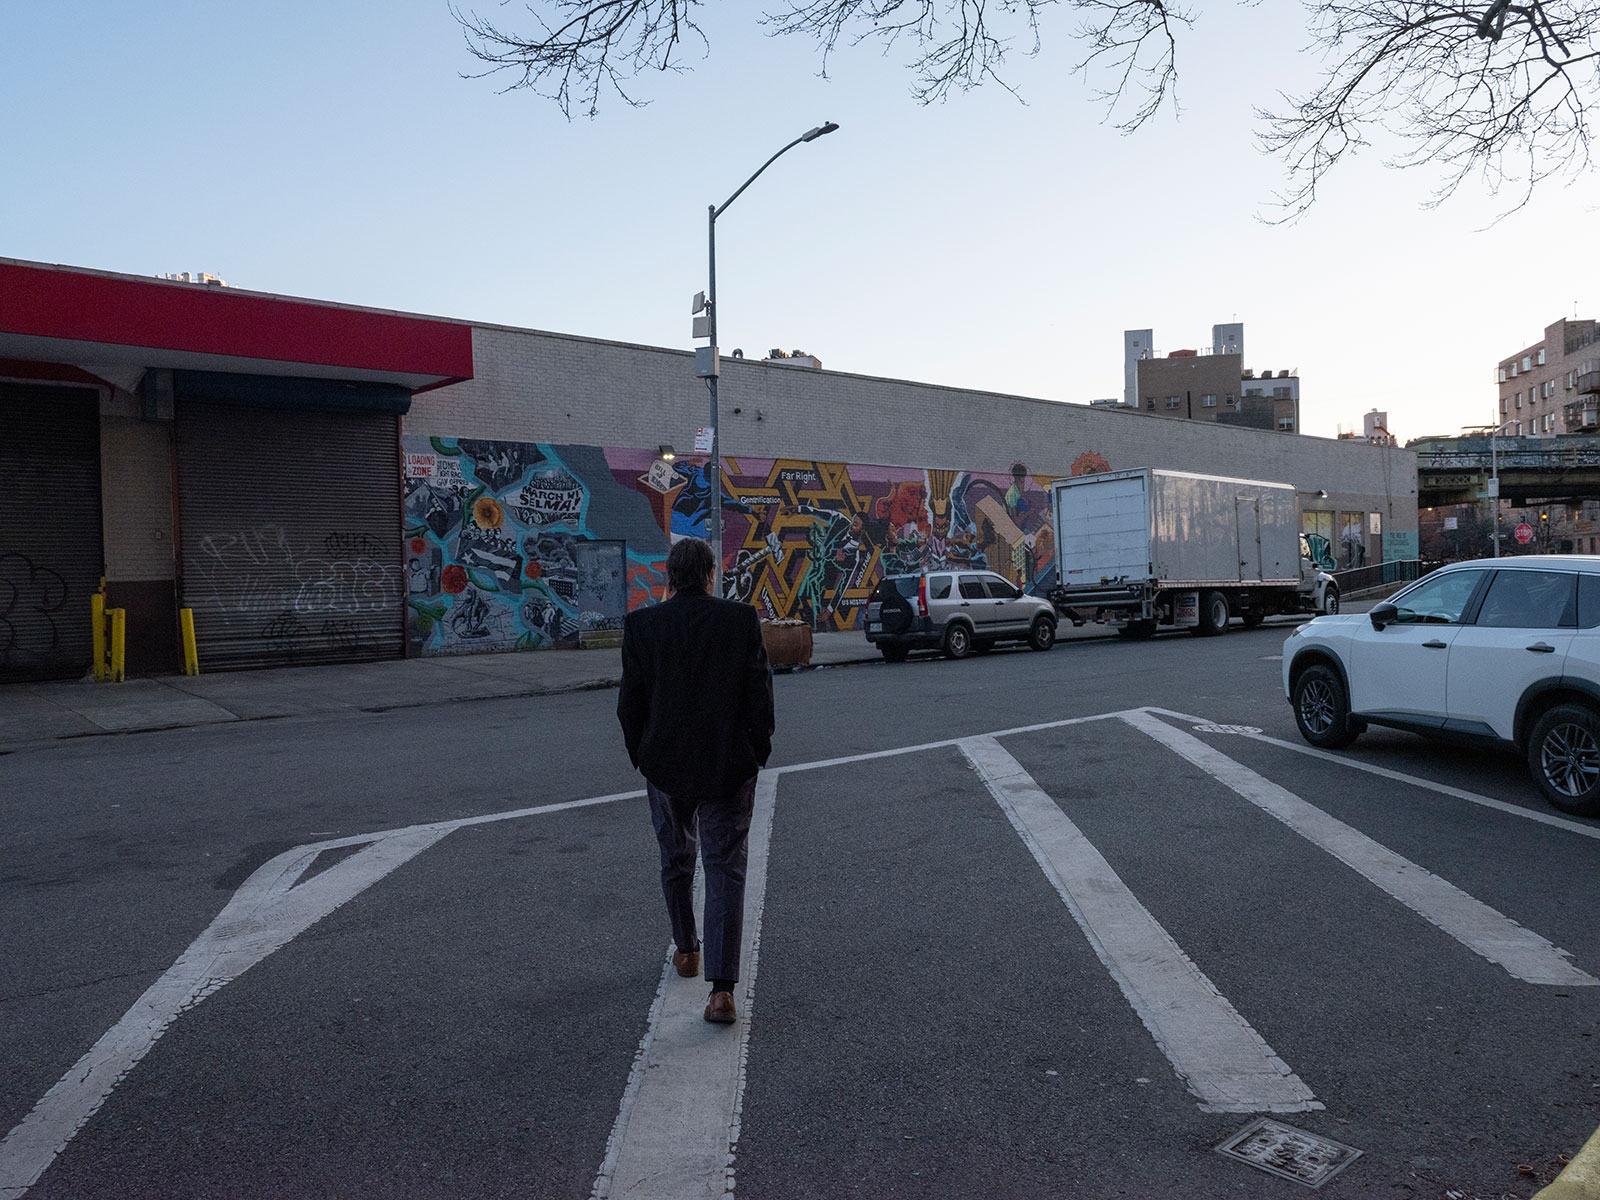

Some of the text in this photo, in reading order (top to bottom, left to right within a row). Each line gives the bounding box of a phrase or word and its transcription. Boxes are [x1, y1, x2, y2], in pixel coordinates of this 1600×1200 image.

[408, 454, 436, 466] LOADING
[411, 466, 433, 477] ZONE
[655, 463, 667, 476] BILL
[781, 470, 816, 484] Far Right
[522, 485, 565, 501] MARCH
[519, 493, 581, 511] SELMA!
